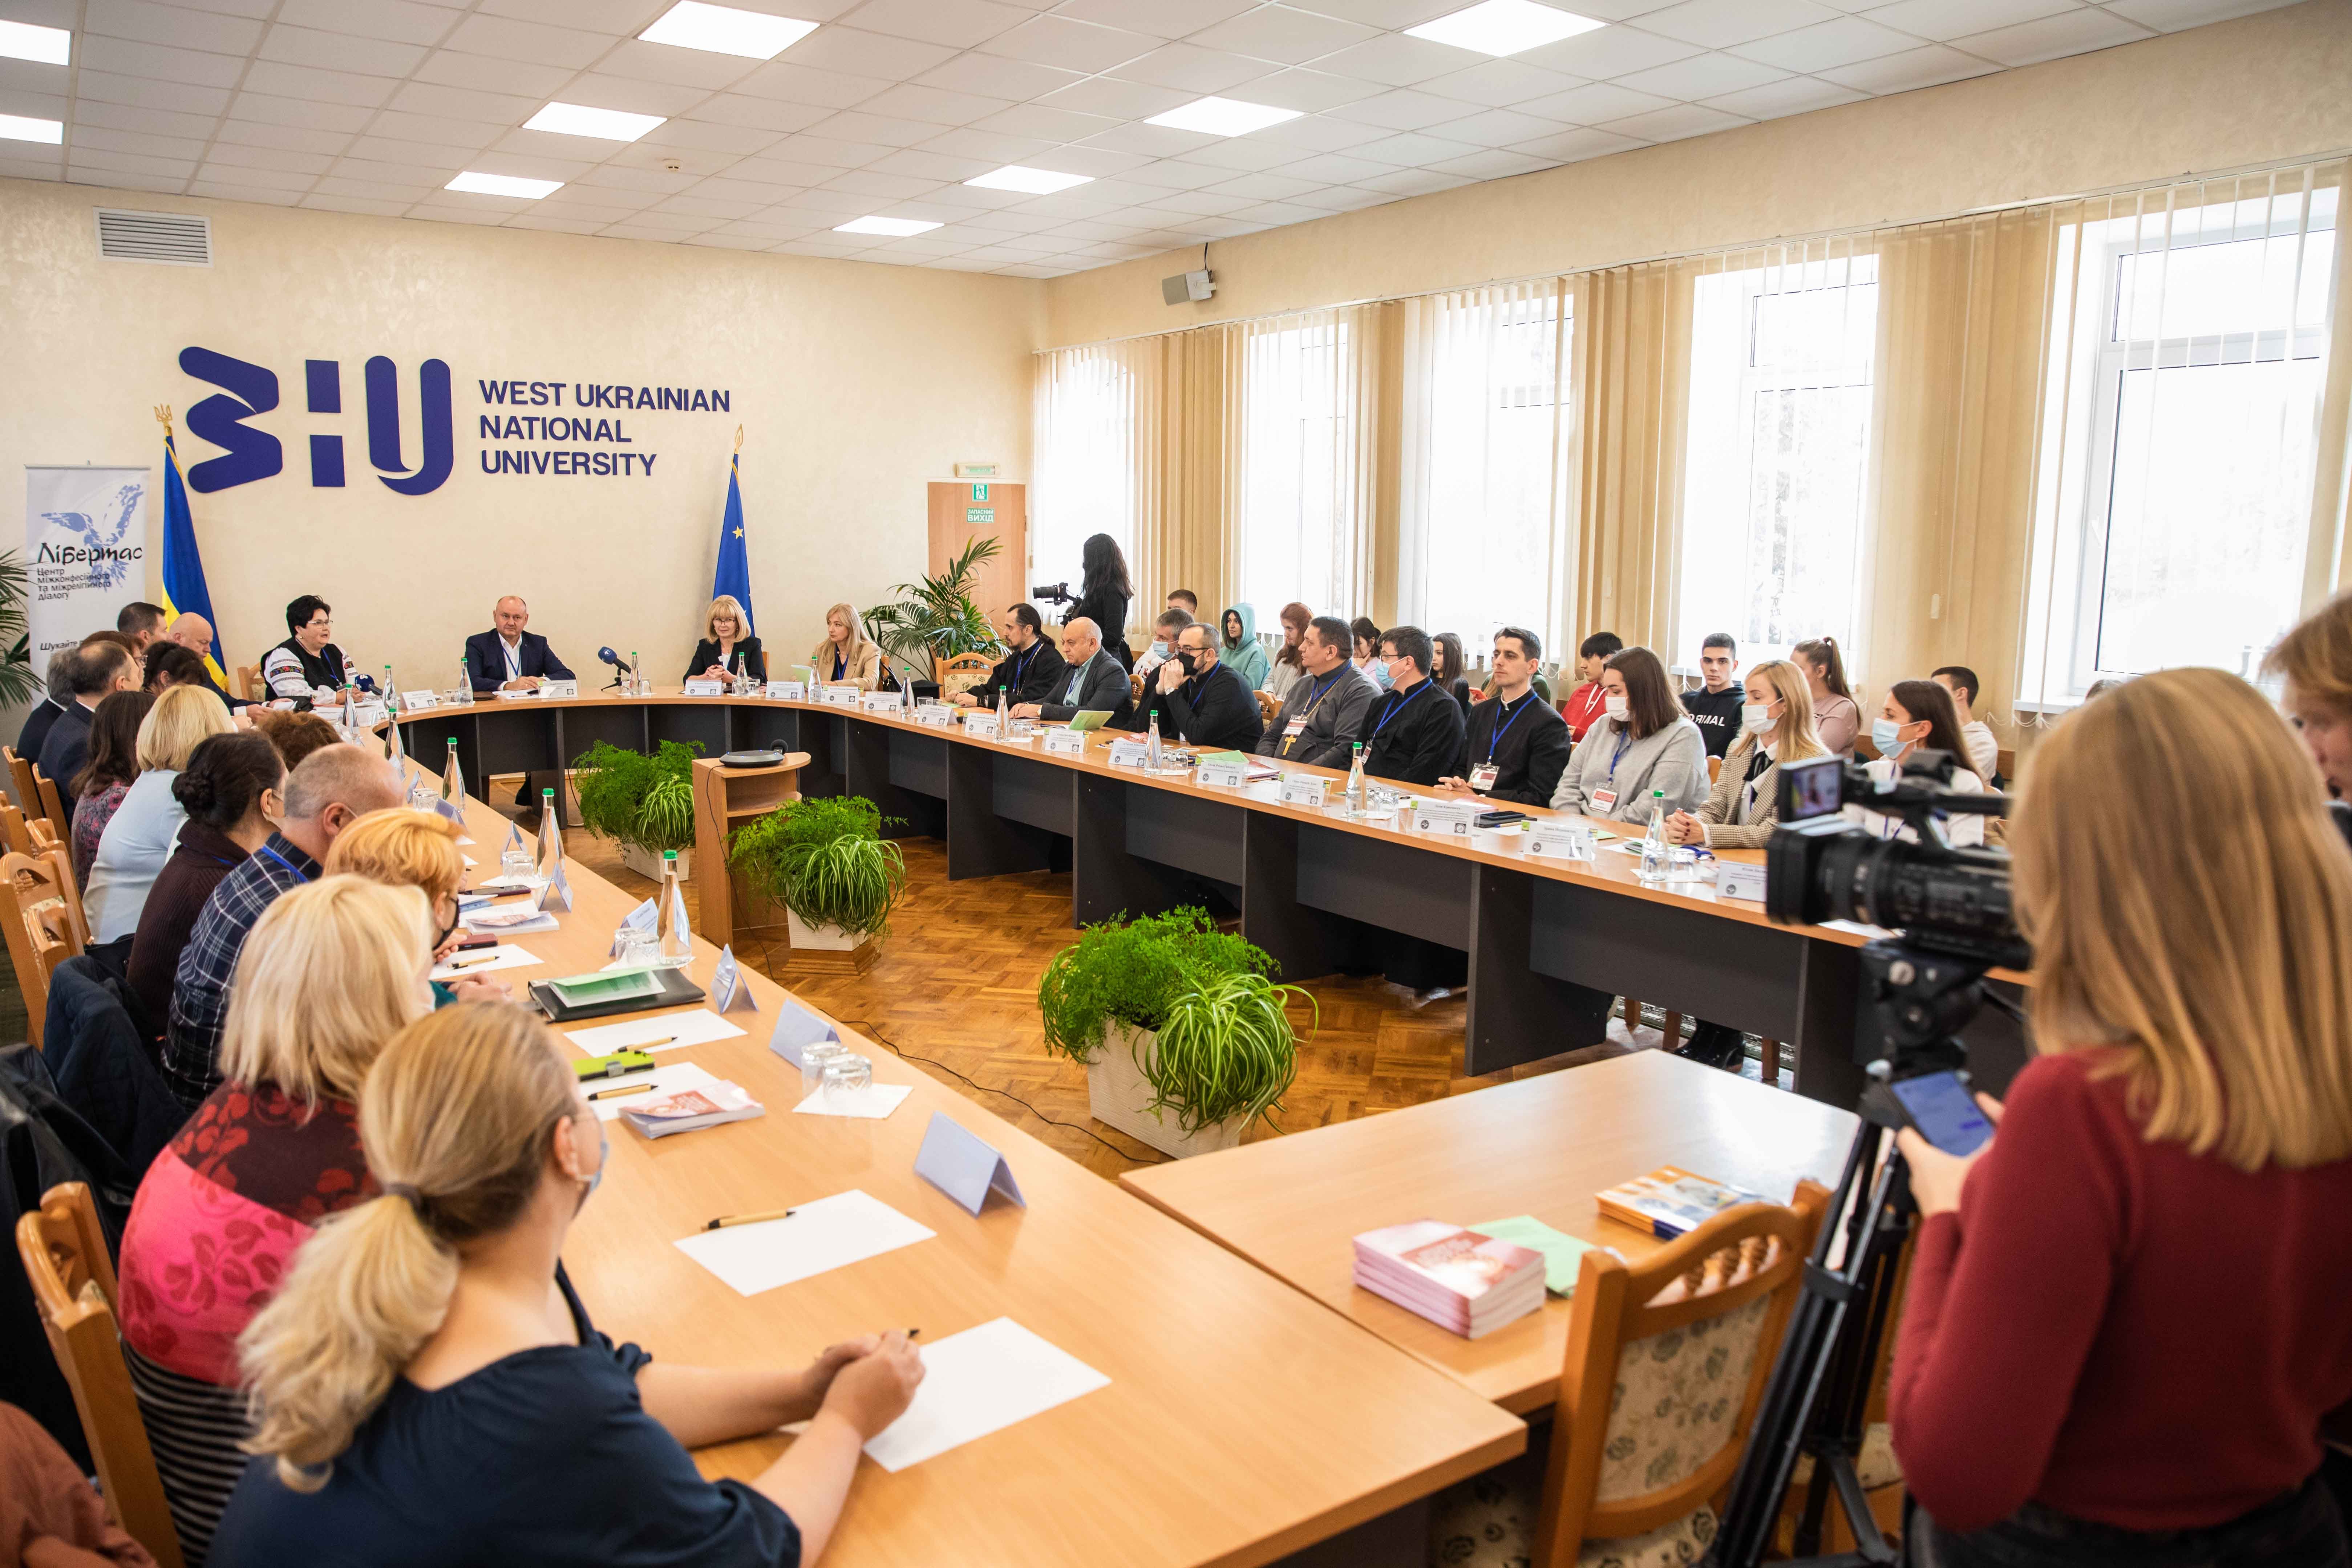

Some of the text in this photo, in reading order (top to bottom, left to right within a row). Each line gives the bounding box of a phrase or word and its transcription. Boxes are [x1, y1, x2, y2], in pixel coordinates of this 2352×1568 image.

[479, 380, 730, 412] WEST UKRAINIAN
[480, 415, 632, 442] NATIONAL
[481, 450, 657, 476] UNIVERSITY
[37, 592, 69, 601] діалогу
[40, 640, 78, 652] Шукайте
